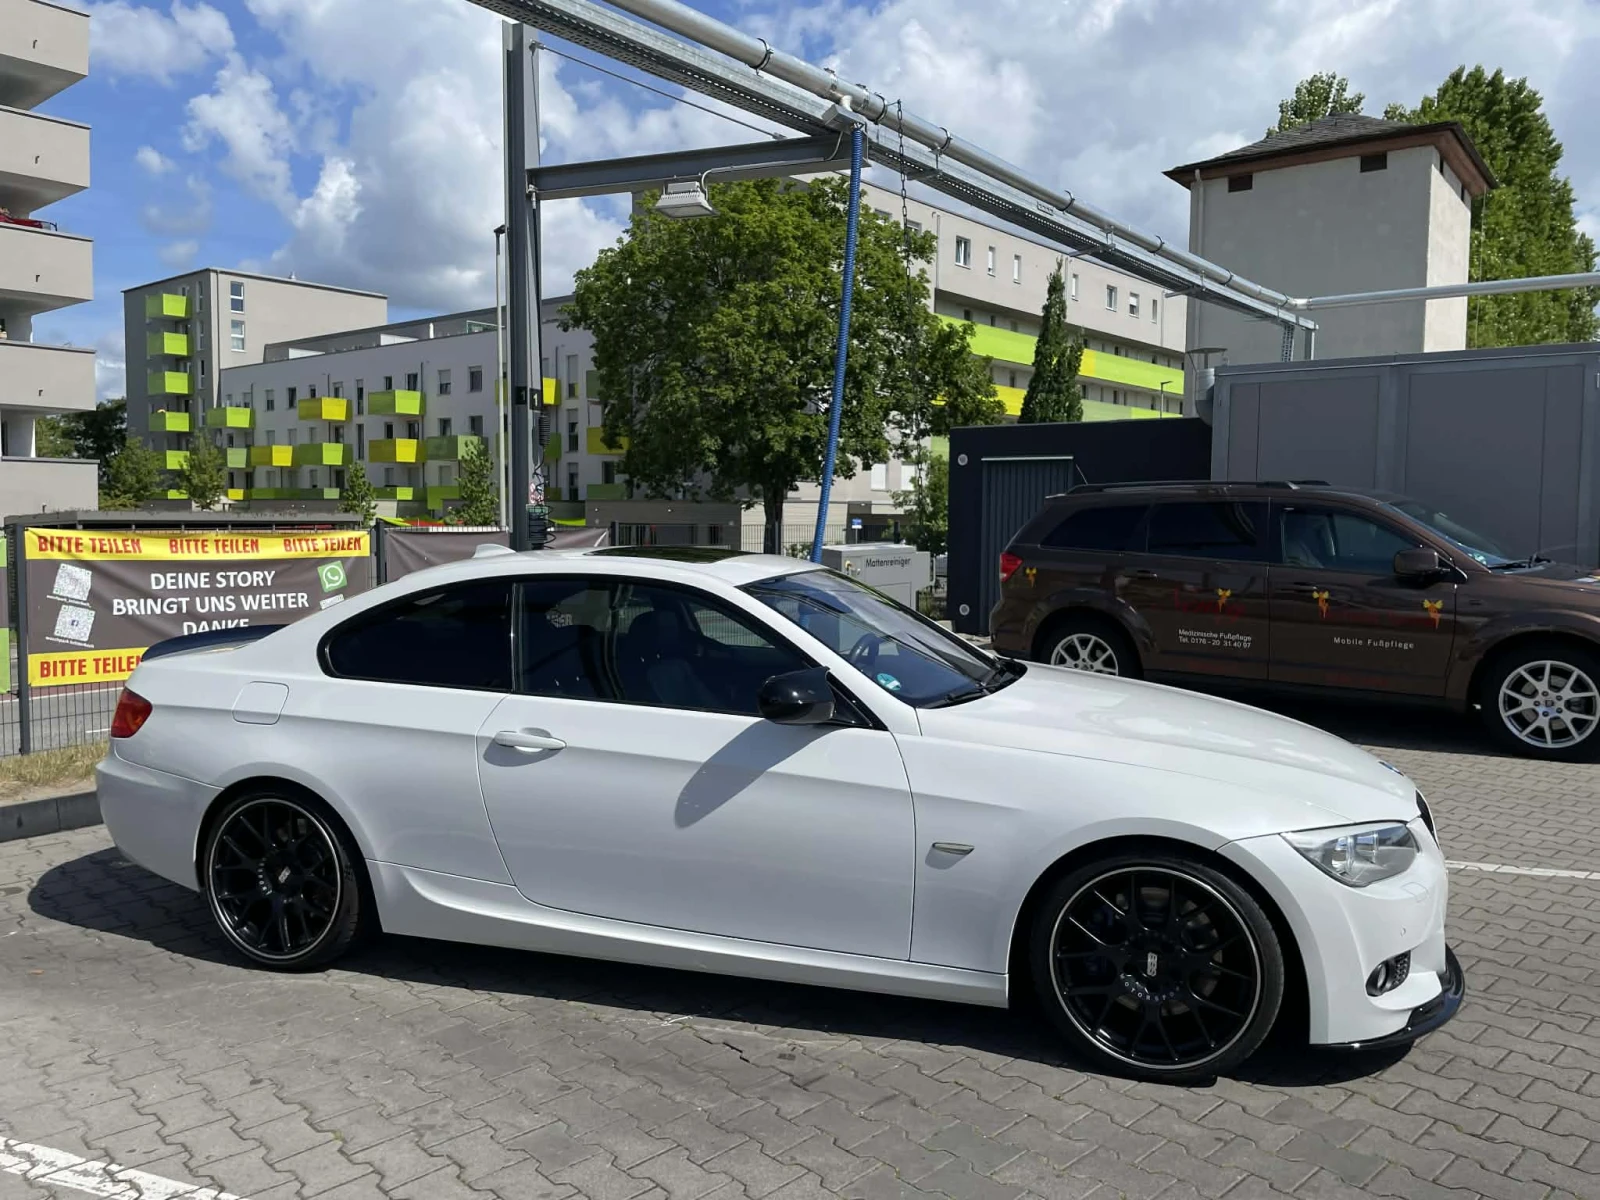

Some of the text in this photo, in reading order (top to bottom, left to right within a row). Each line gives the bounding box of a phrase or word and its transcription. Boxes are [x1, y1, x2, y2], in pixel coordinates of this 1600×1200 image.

[38, 536, 142, 554] BITTE TEILEN
[169, 538, 260, 554] BITTE TEILEN
[284, 537, 361, 552] BITTE TEILEN
[866, 557, 911, 568] Mattenreiniger
[151, 570, 275, 590] DEINE STORY
[112, 597, 190, 615] BRINGT
[196, 595, 236, 613] UNS
[240, 592, 309, 611] WEITER
[1178, 629, 1218, 639] Medizinische
[1333, 636, 1415, 650] Mobile Fußpflege
[40, 659, 87, 678] BITTE
